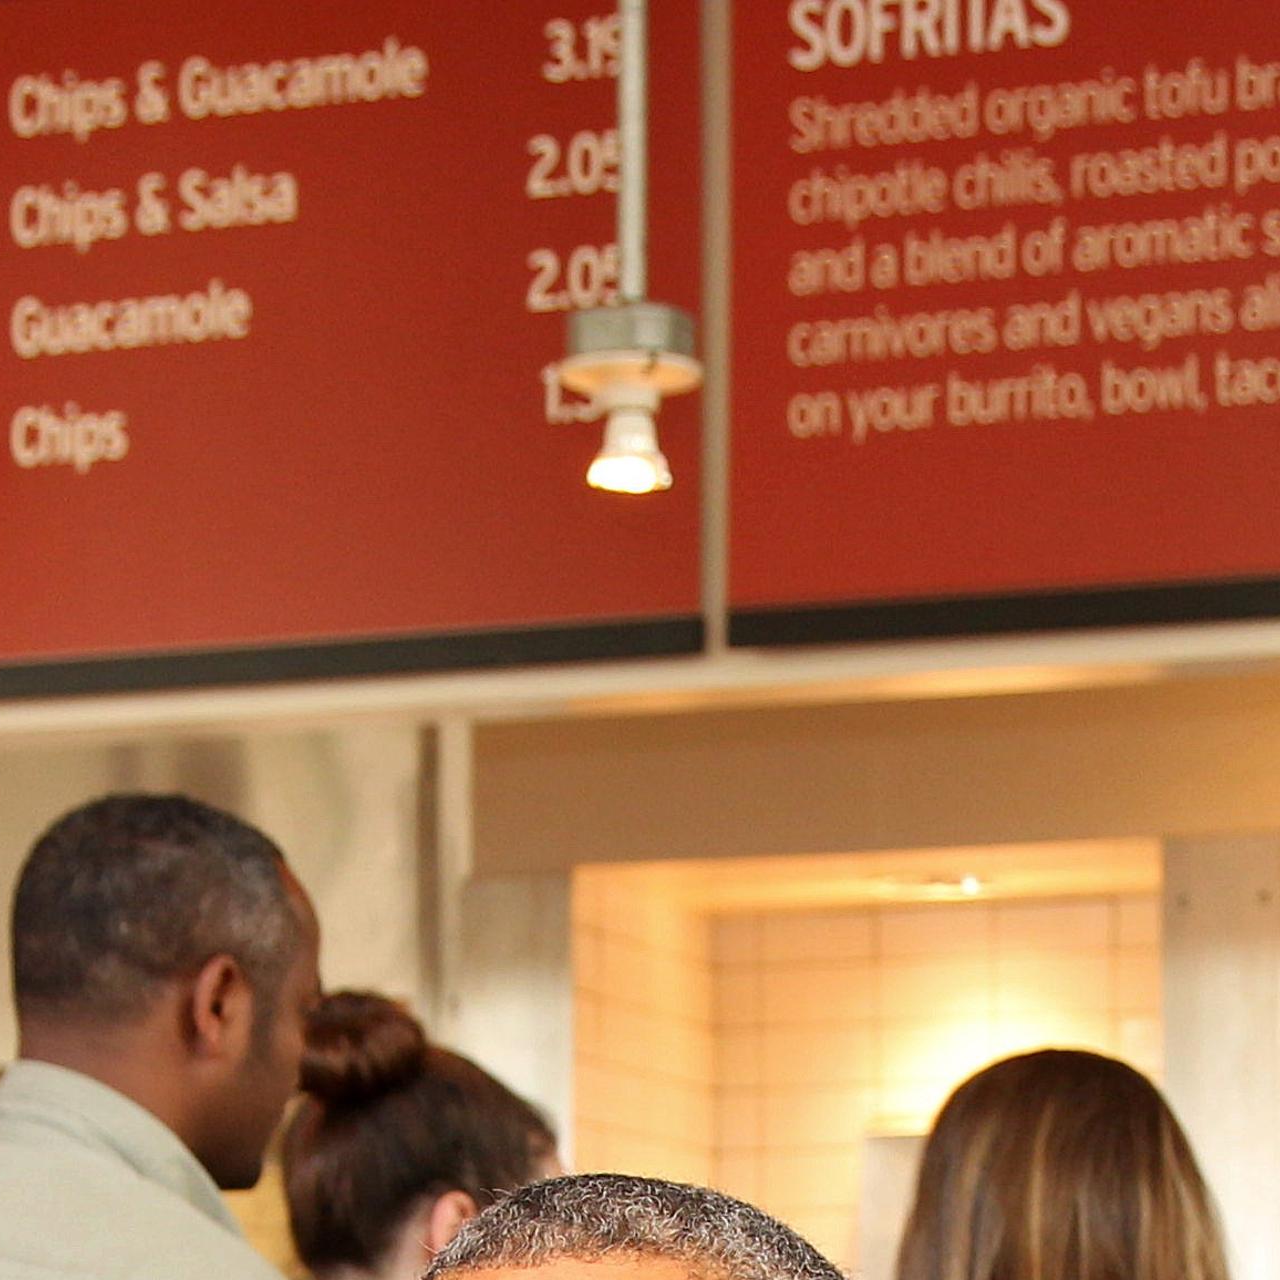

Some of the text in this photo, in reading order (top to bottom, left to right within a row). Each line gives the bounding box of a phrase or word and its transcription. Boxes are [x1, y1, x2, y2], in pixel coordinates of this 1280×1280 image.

[787, 0, 1071, 73] SOFRITAS
[10, 34, 429, 143] Chips & Guacamole
[788, 84, 979, 154] Shredded
[984, 66, 1137, 143] organic
[1143, 55, 1229, 120] tofu
[10, 162, 299, 253] Chips & Salsa
[787, 158, 948, 233] chipotle
[1070, 128, 1228, 199] roasted
[787, 234, 865, 297] and
[870, 242, 898, 291] a
[903, 221, 1017, 287] blend
[1022, 215, 1067, 278] of
[1072, 202, 1255, 272] aromatic
[10, 278, 253, 360] Guacamole
[786, 302, 999, 369] carnivores
[1002, 286, 1083, 351] and
[1086, 286, 1234, 351] vegans
[10, 400, 128, 474] Chips
[786, 390, 843, 440] on
[846, 381, 941, 447] your
